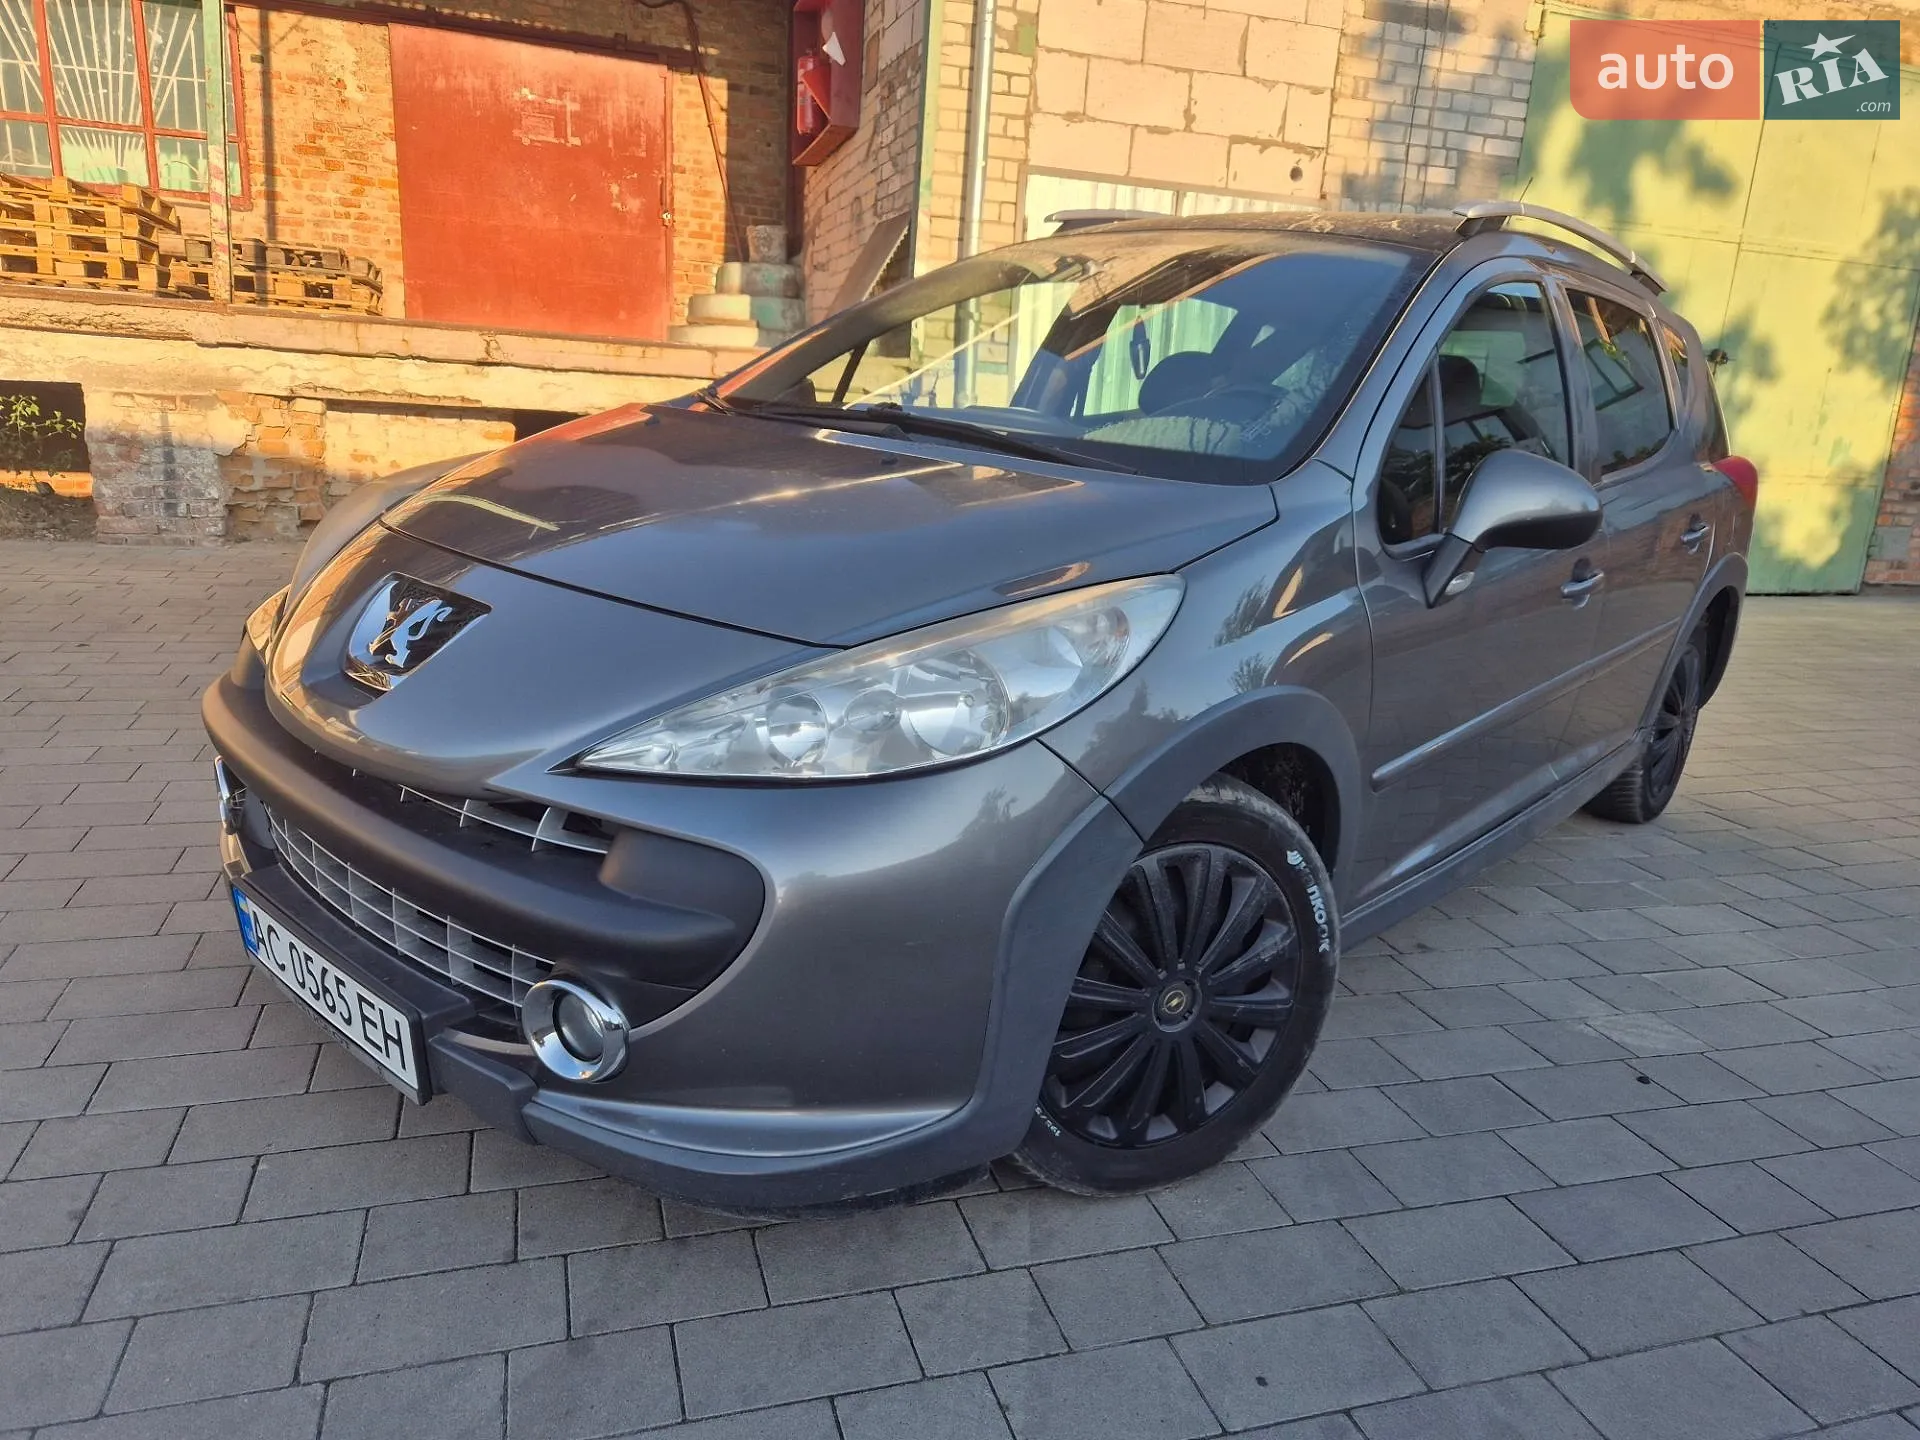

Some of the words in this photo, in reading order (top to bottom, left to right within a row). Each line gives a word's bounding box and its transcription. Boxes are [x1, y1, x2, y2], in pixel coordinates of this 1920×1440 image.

[252, 910, 286, 972] AC
[288, 941, 352, 1027] 0565
[356, 991, 407, 1072] EH
